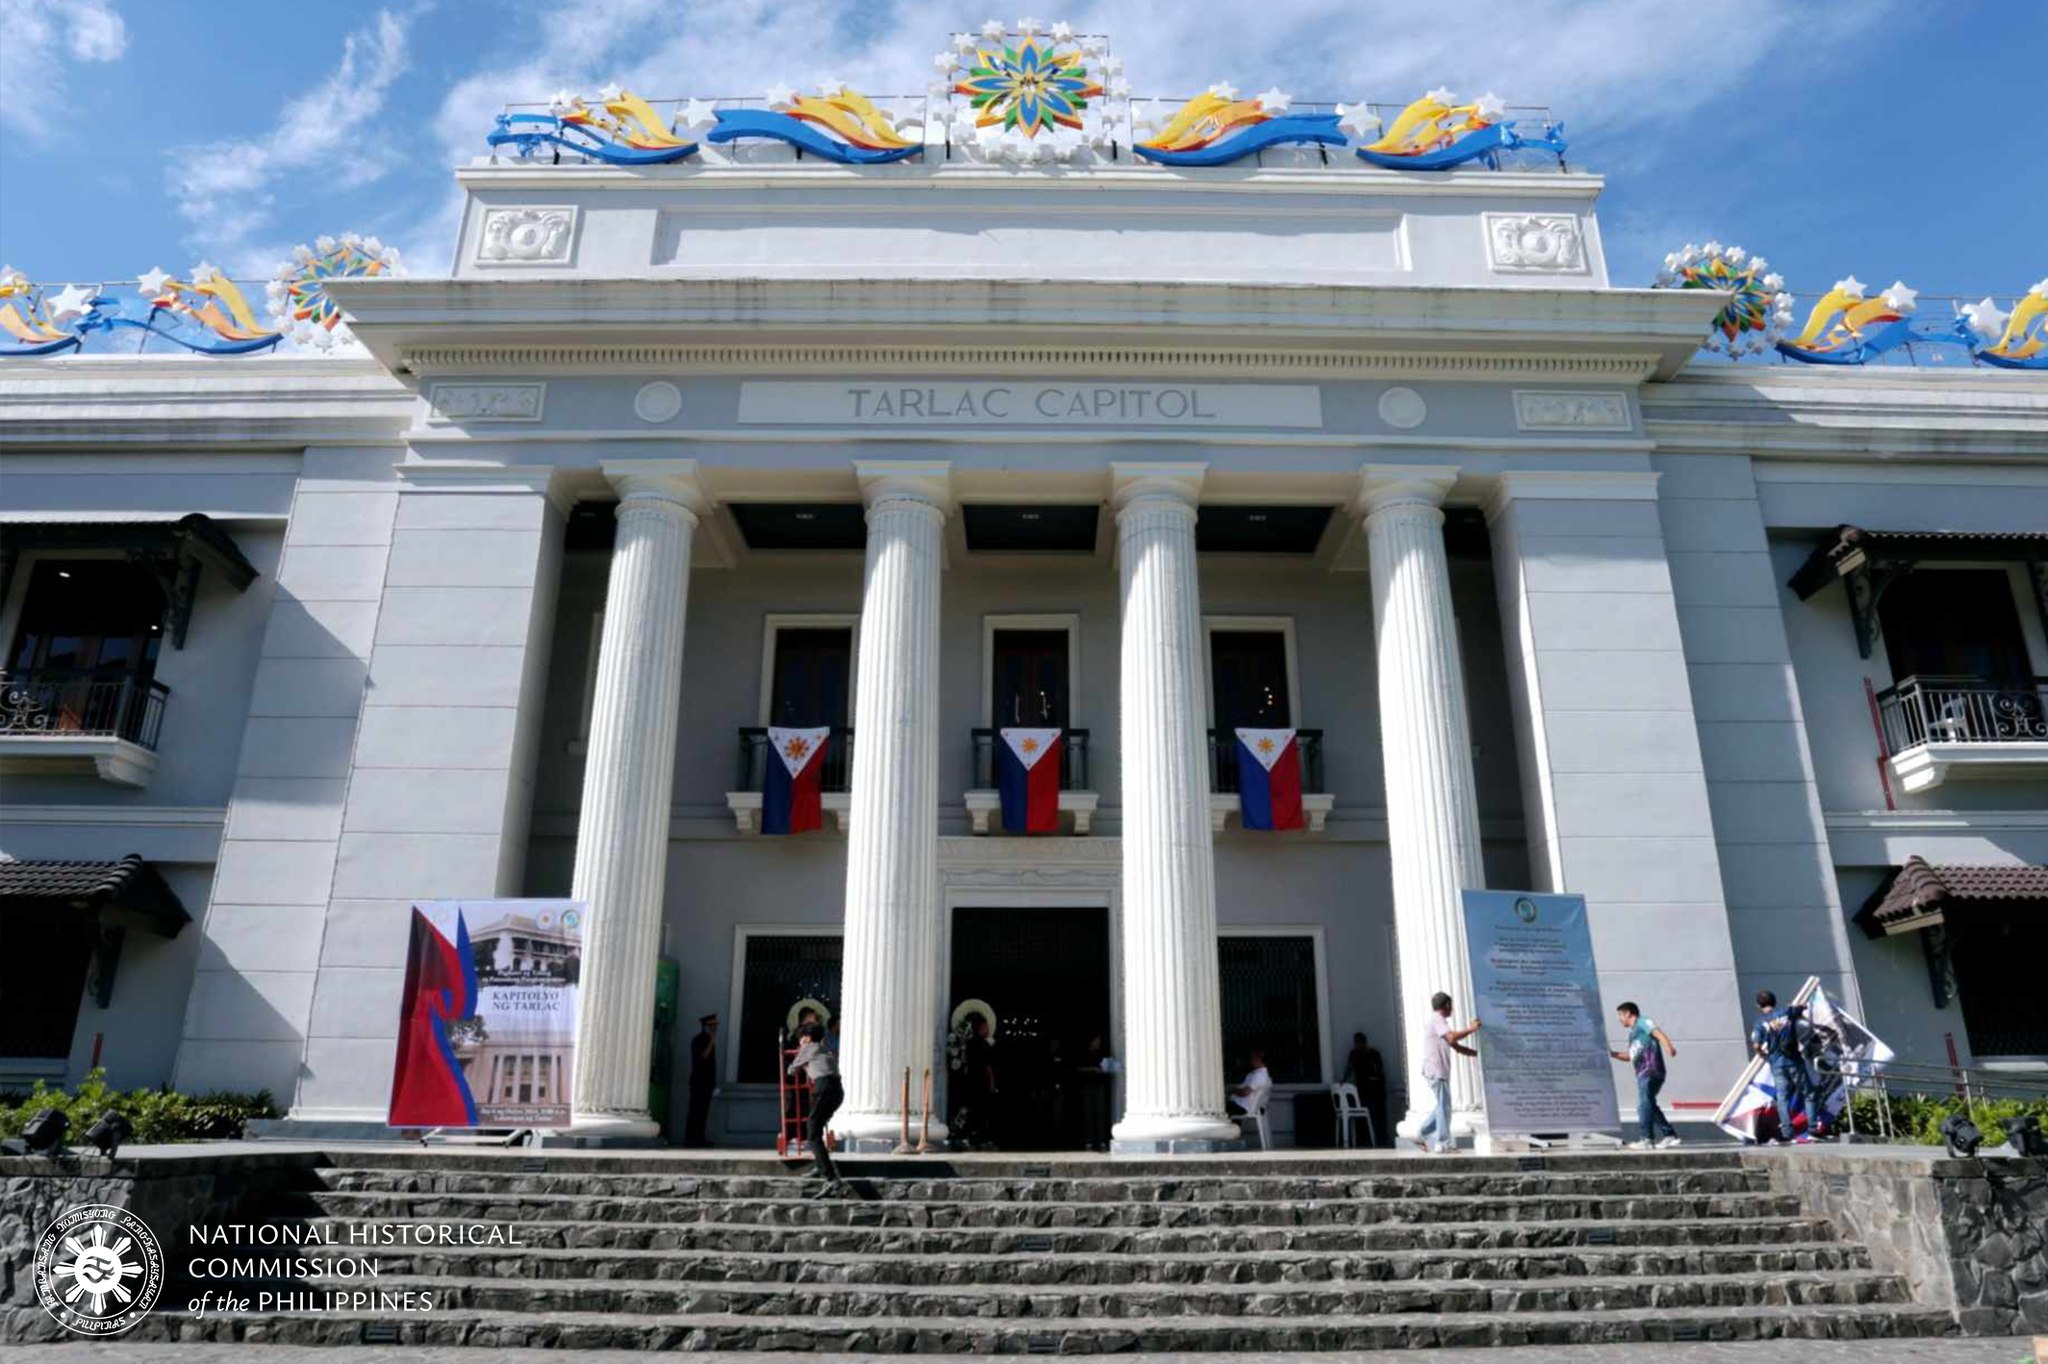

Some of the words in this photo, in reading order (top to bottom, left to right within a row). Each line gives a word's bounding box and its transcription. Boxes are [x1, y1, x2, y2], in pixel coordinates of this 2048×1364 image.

[847, 388, 1011, 418] TARLAC
[1036, 389, 1215, 419] CAPITOL
[493, 992, 559, 1001] KAPITOLYO
[493, 1001, 510, 1010] NG
[515, 1001, 560, 1010] TARLAC
